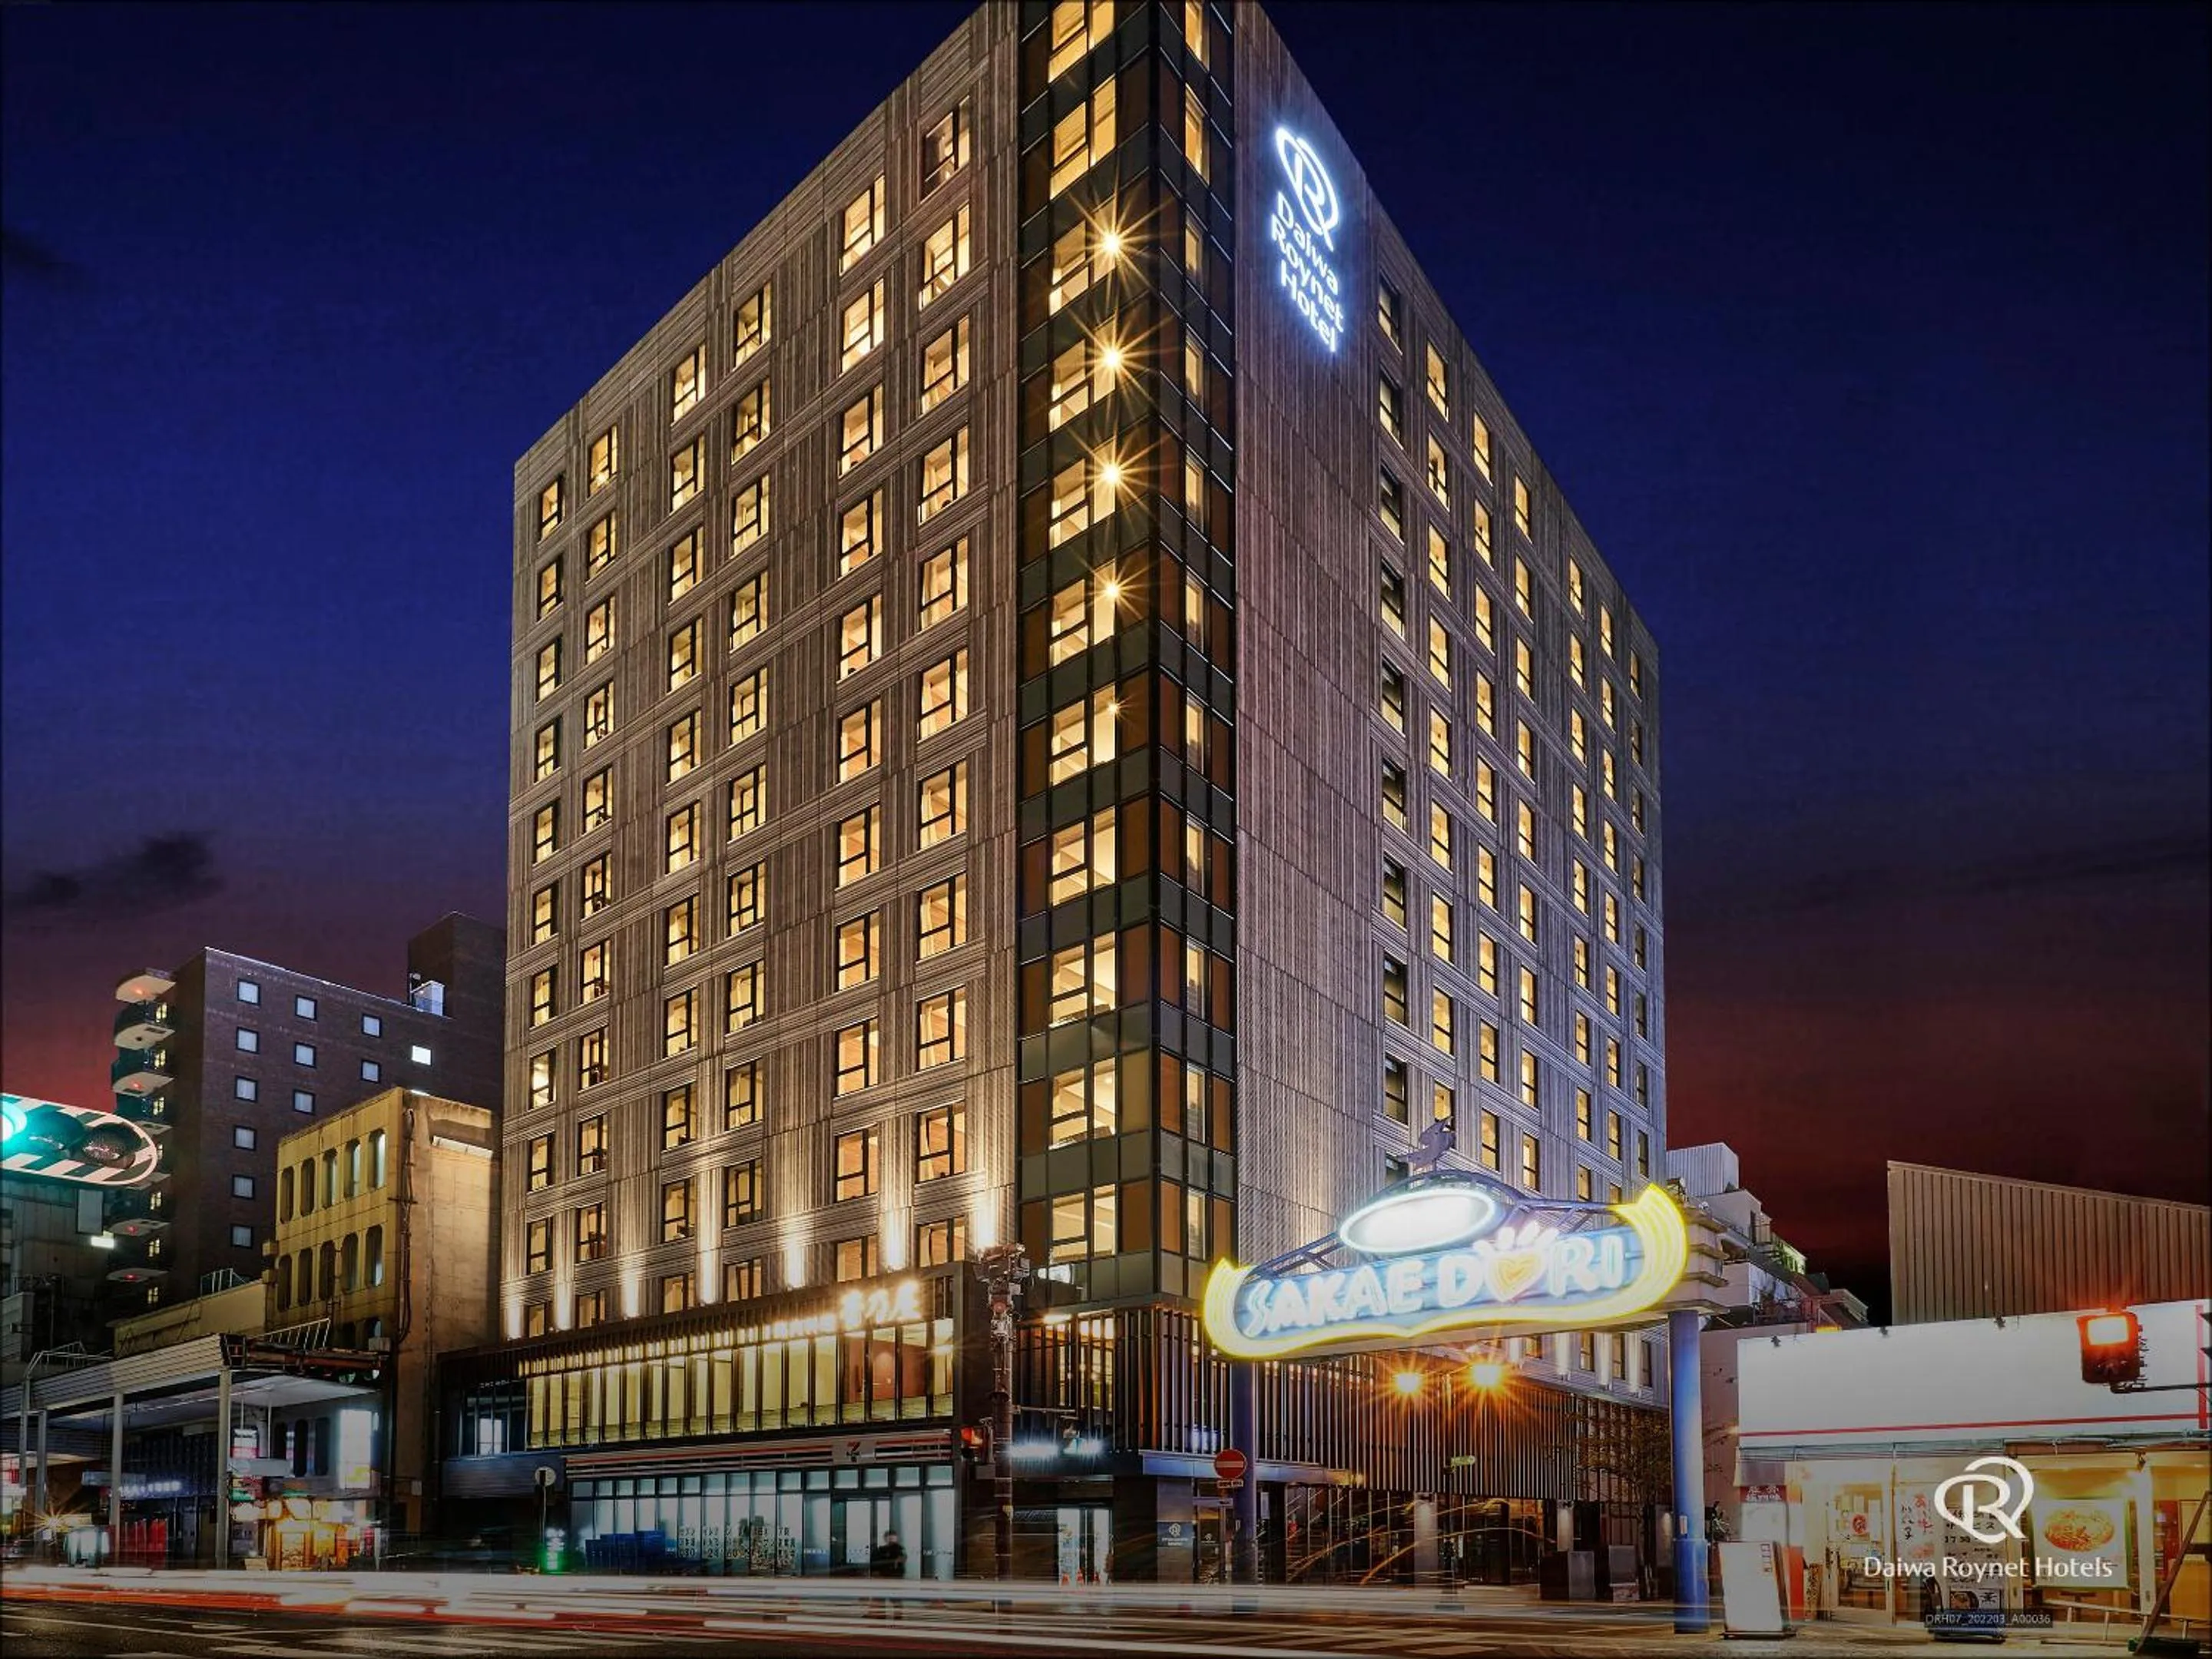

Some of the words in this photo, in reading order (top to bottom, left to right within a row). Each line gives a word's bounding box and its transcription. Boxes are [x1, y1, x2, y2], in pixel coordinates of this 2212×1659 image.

[1271, 214, 1343, 333] Roynet
[1277, 190, 1338, 295] Daiwa
[1280, 260, 1336, 352] Hotel
[1243, 1258, 1426, 1338] SAKAE
